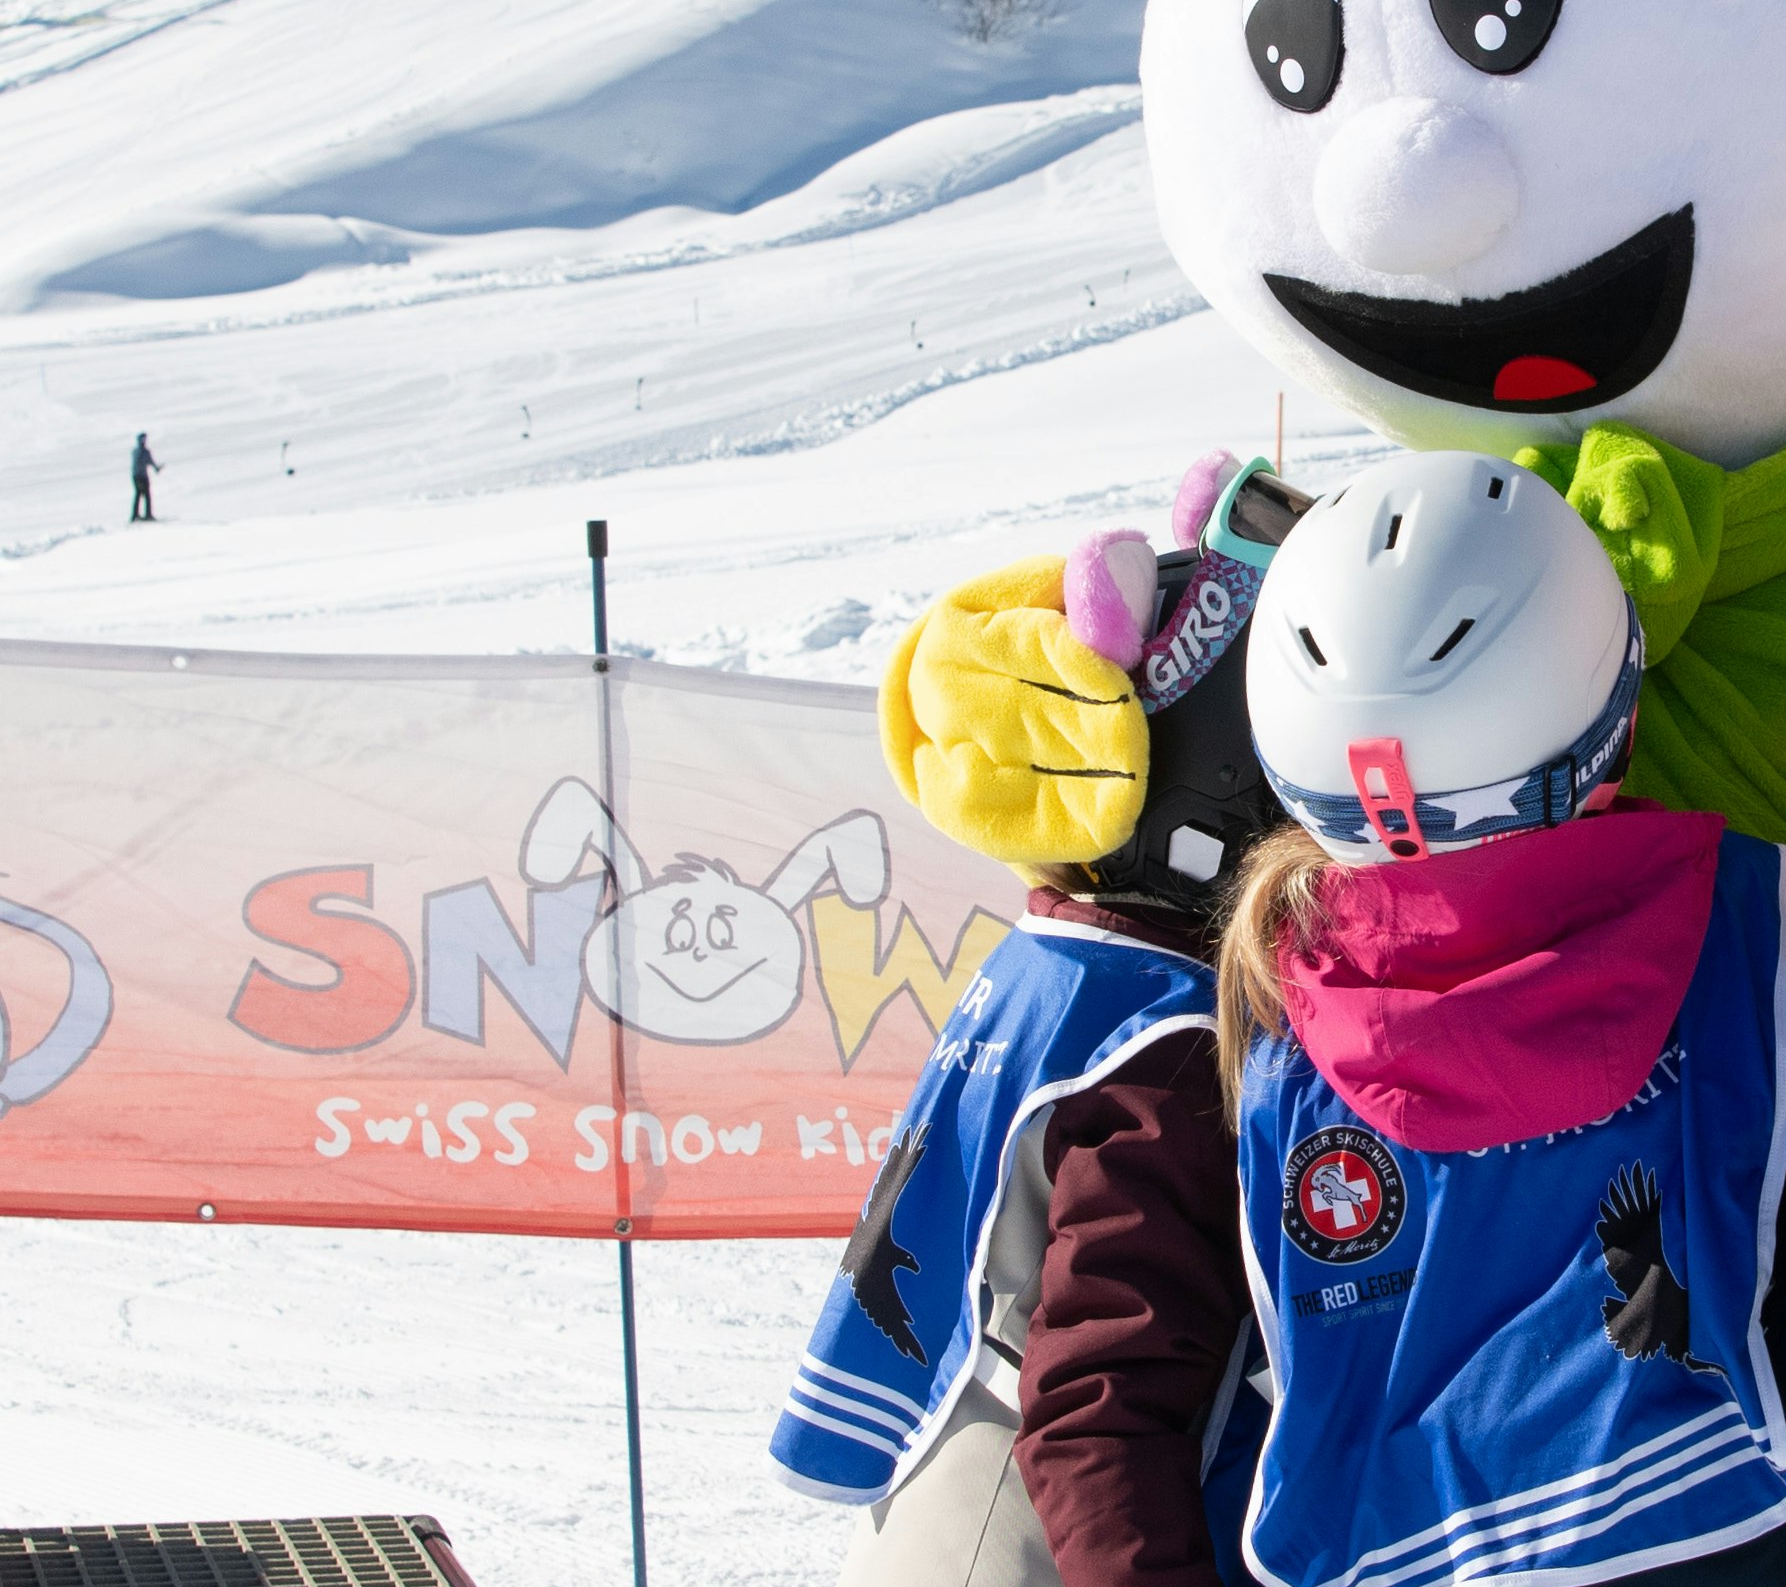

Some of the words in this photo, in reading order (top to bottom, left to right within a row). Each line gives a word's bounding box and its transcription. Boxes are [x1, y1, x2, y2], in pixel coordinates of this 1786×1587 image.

[1146, 580, 1231, 691] GIRO
[1282, 1134, 1332, 1210] SCHWEIZER
[1335, 1132, 1398, 1188] SKISCHULE
